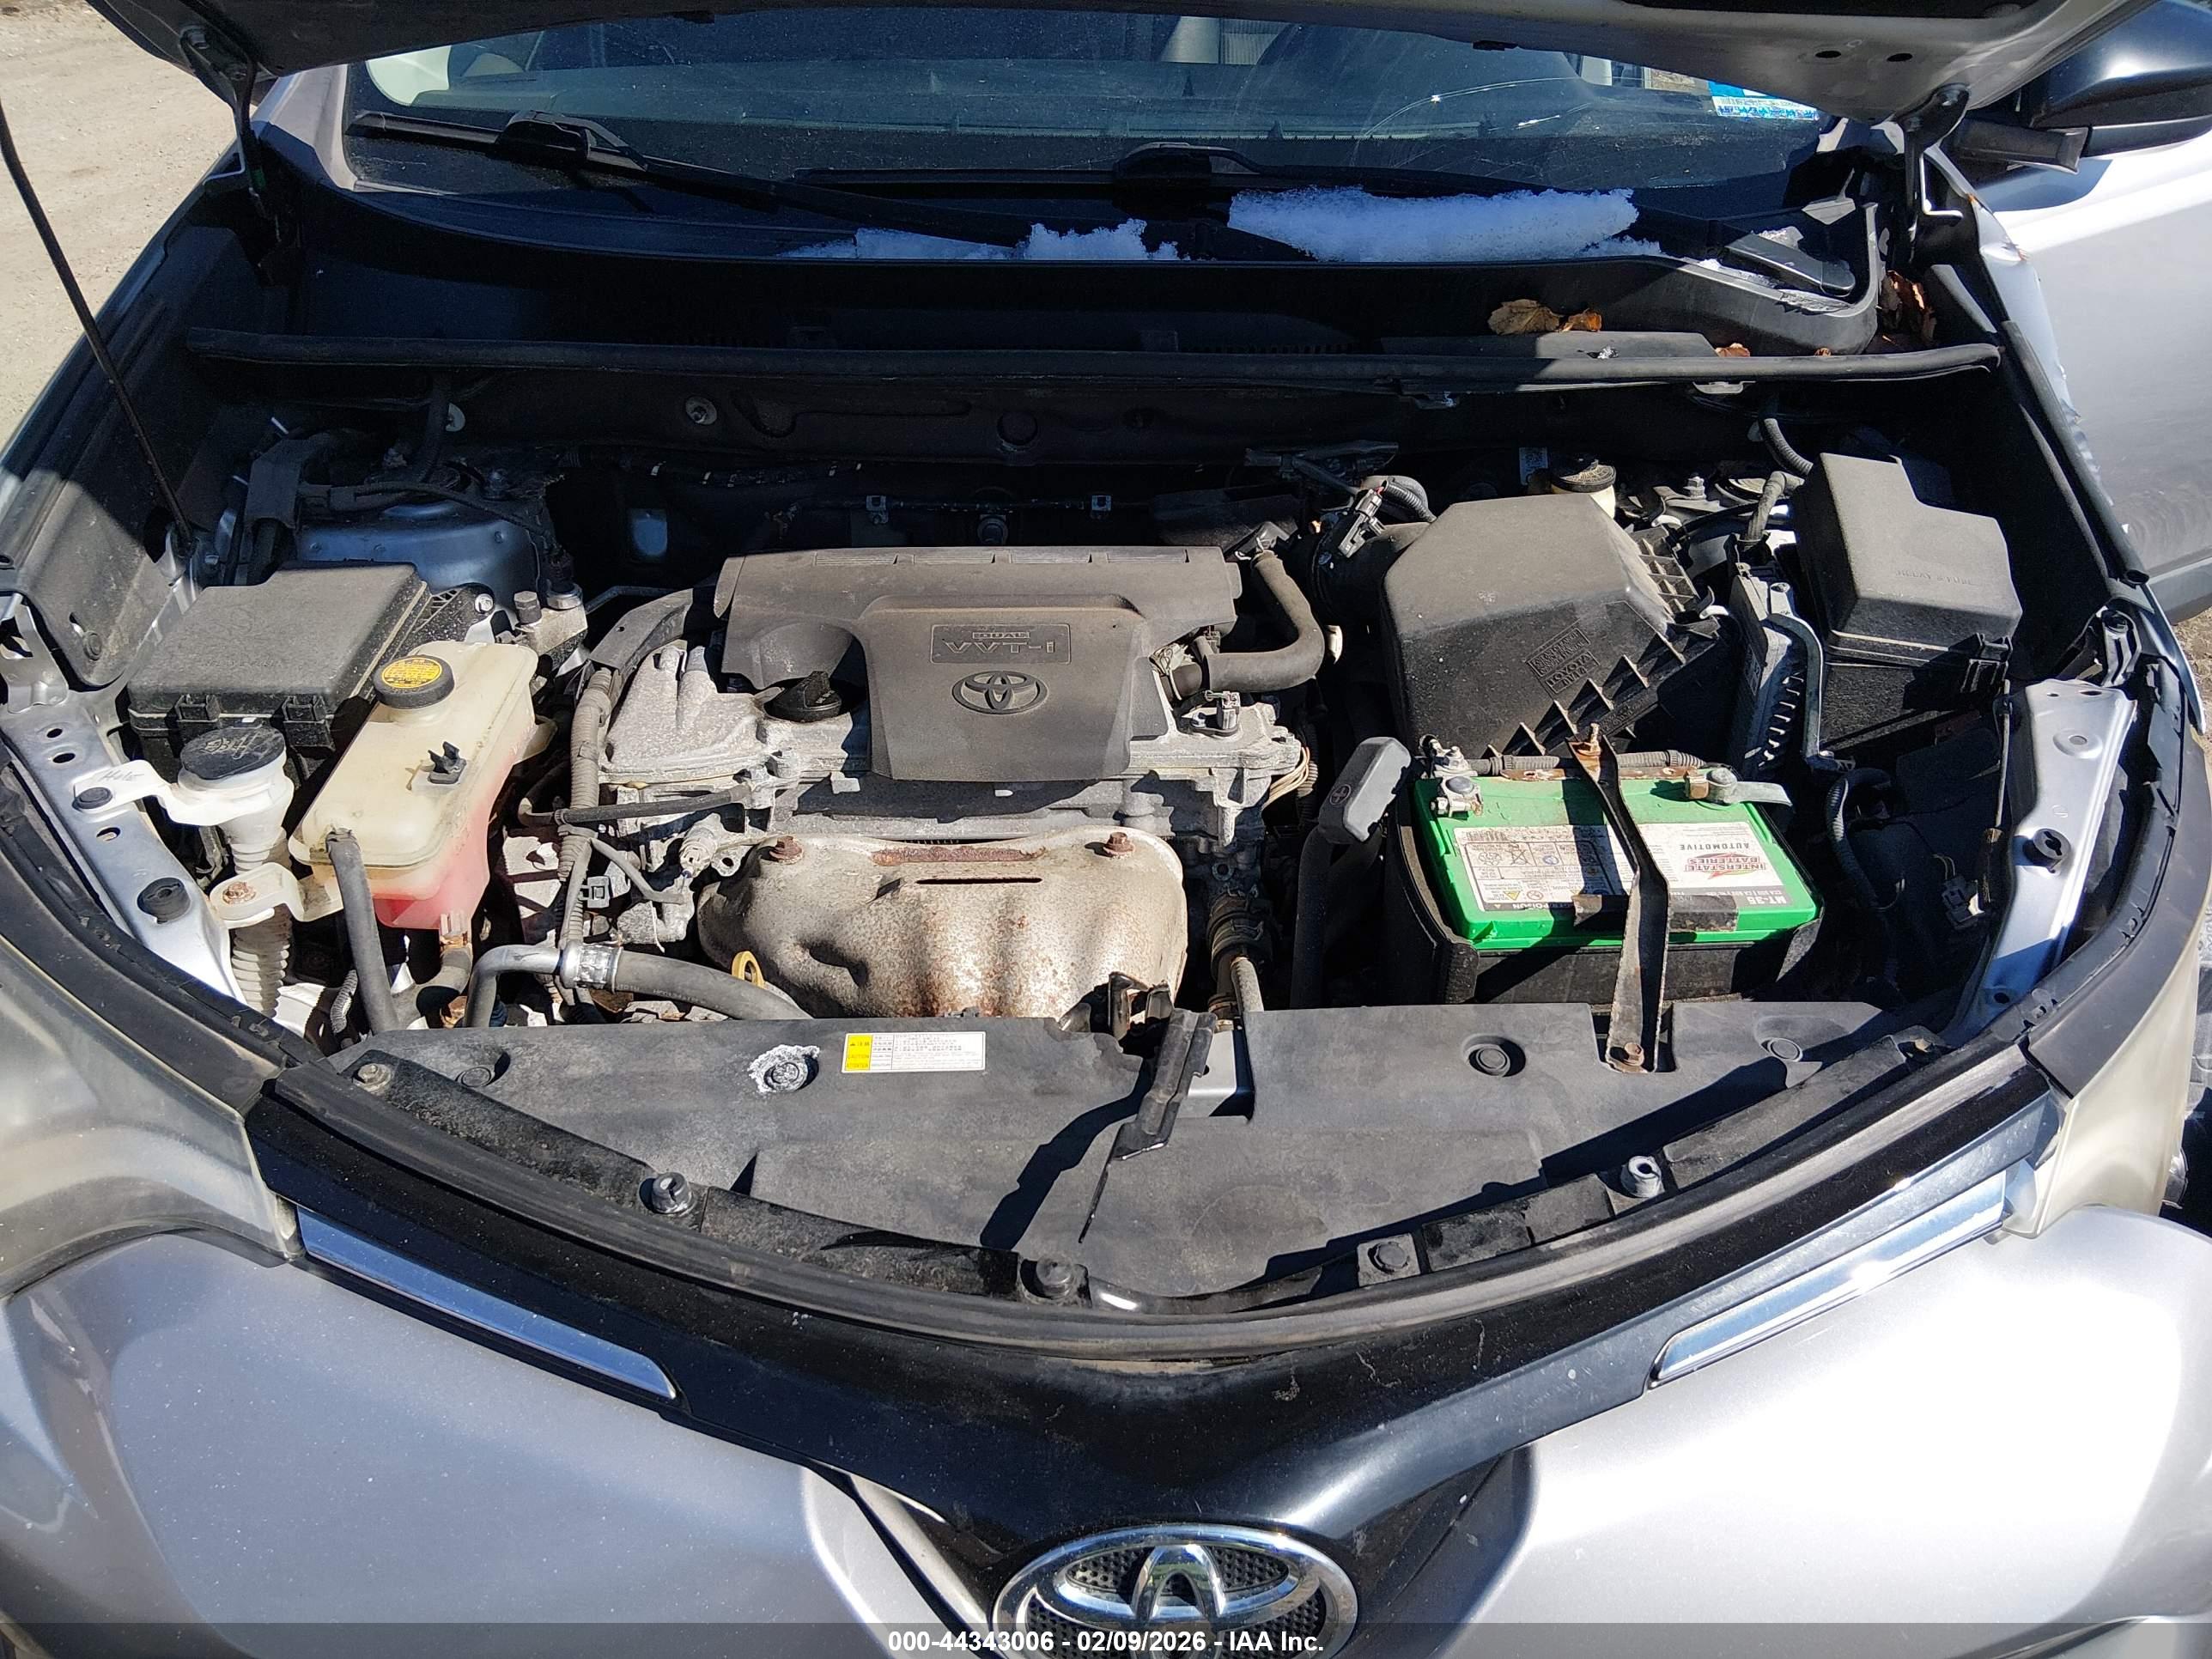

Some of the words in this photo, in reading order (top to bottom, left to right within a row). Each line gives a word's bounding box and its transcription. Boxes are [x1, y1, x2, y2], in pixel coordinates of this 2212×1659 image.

[1547, 653, 1593, 685] TOYOTA
[1680, 842, 1750, 851] AUTOMOTIVE
[1747, 896, 1787, 905] MT-35
